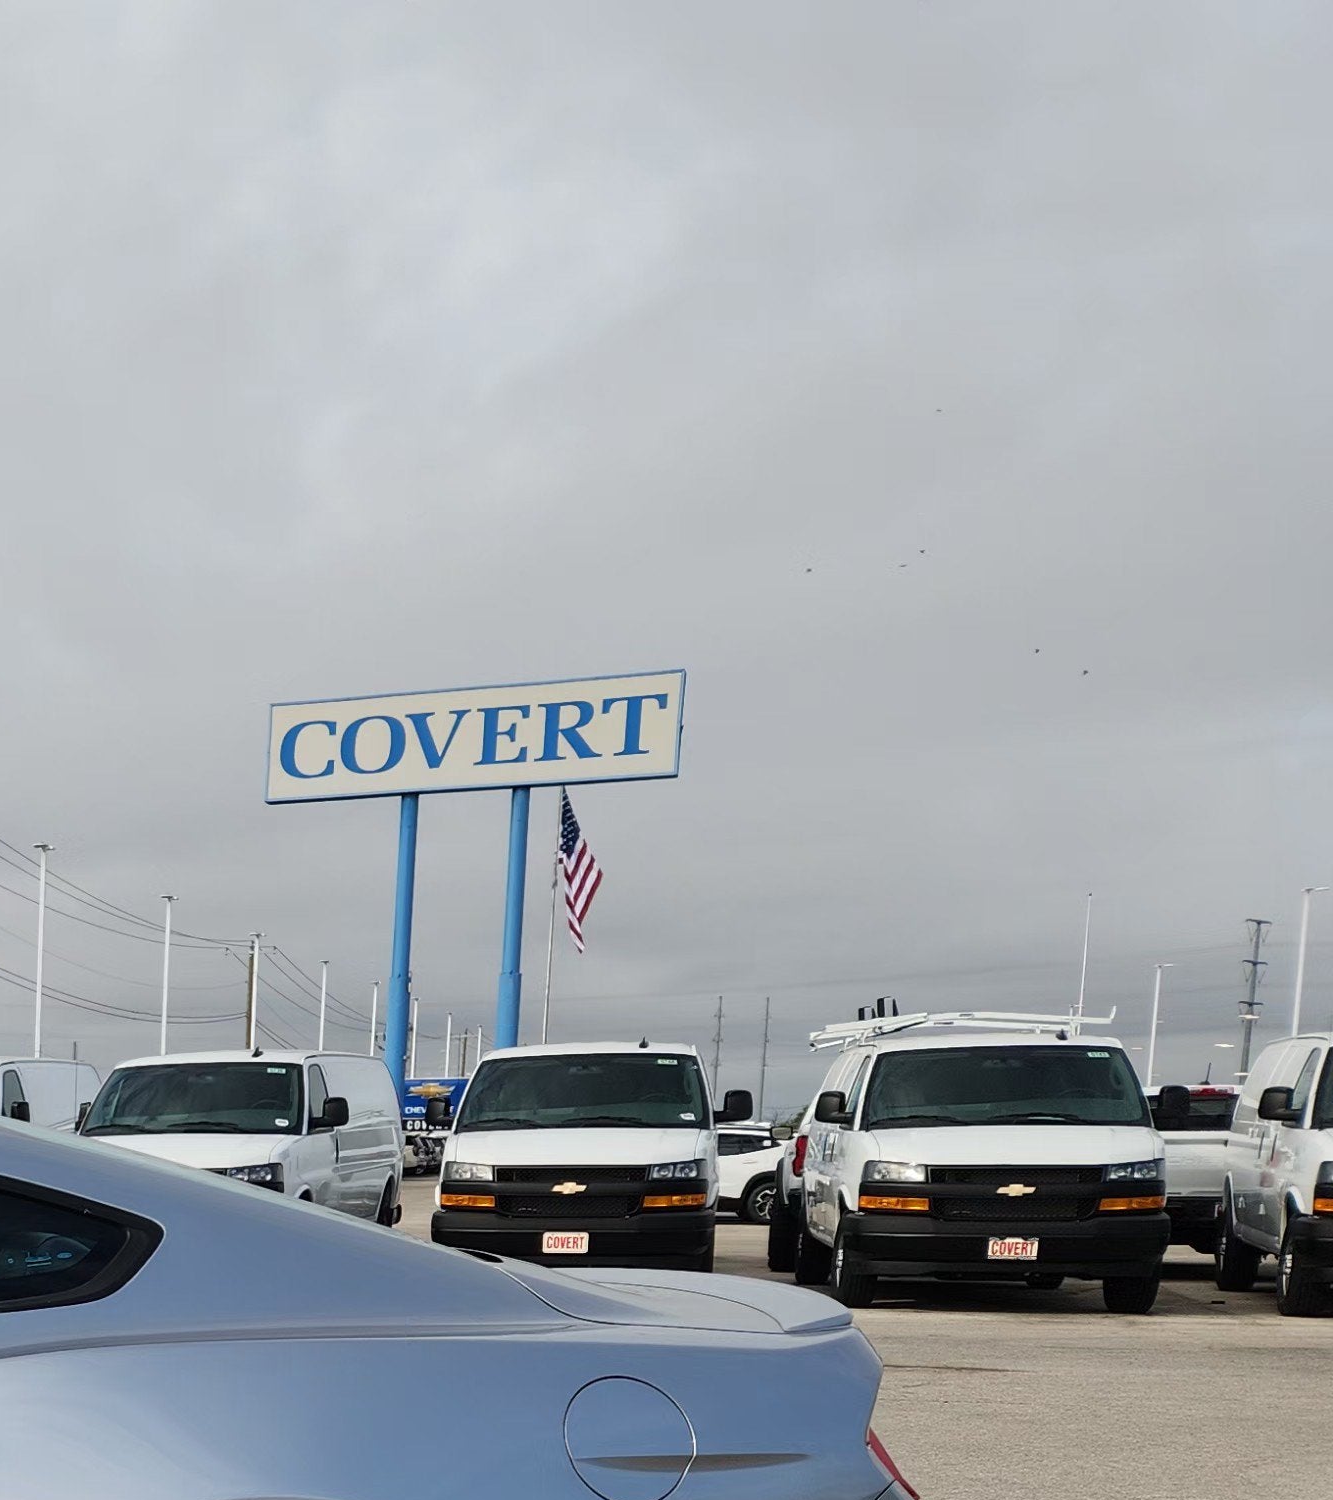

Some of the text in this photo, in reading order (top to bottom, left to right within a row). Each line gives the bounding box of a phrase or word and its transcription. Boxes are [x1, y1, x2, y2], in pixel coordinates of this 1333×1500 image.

[280, 693, 668, 779] COVERT
[546, 1236, 585, 1249] COVERT
[991, 1241, 1035, 1256] COVERT
